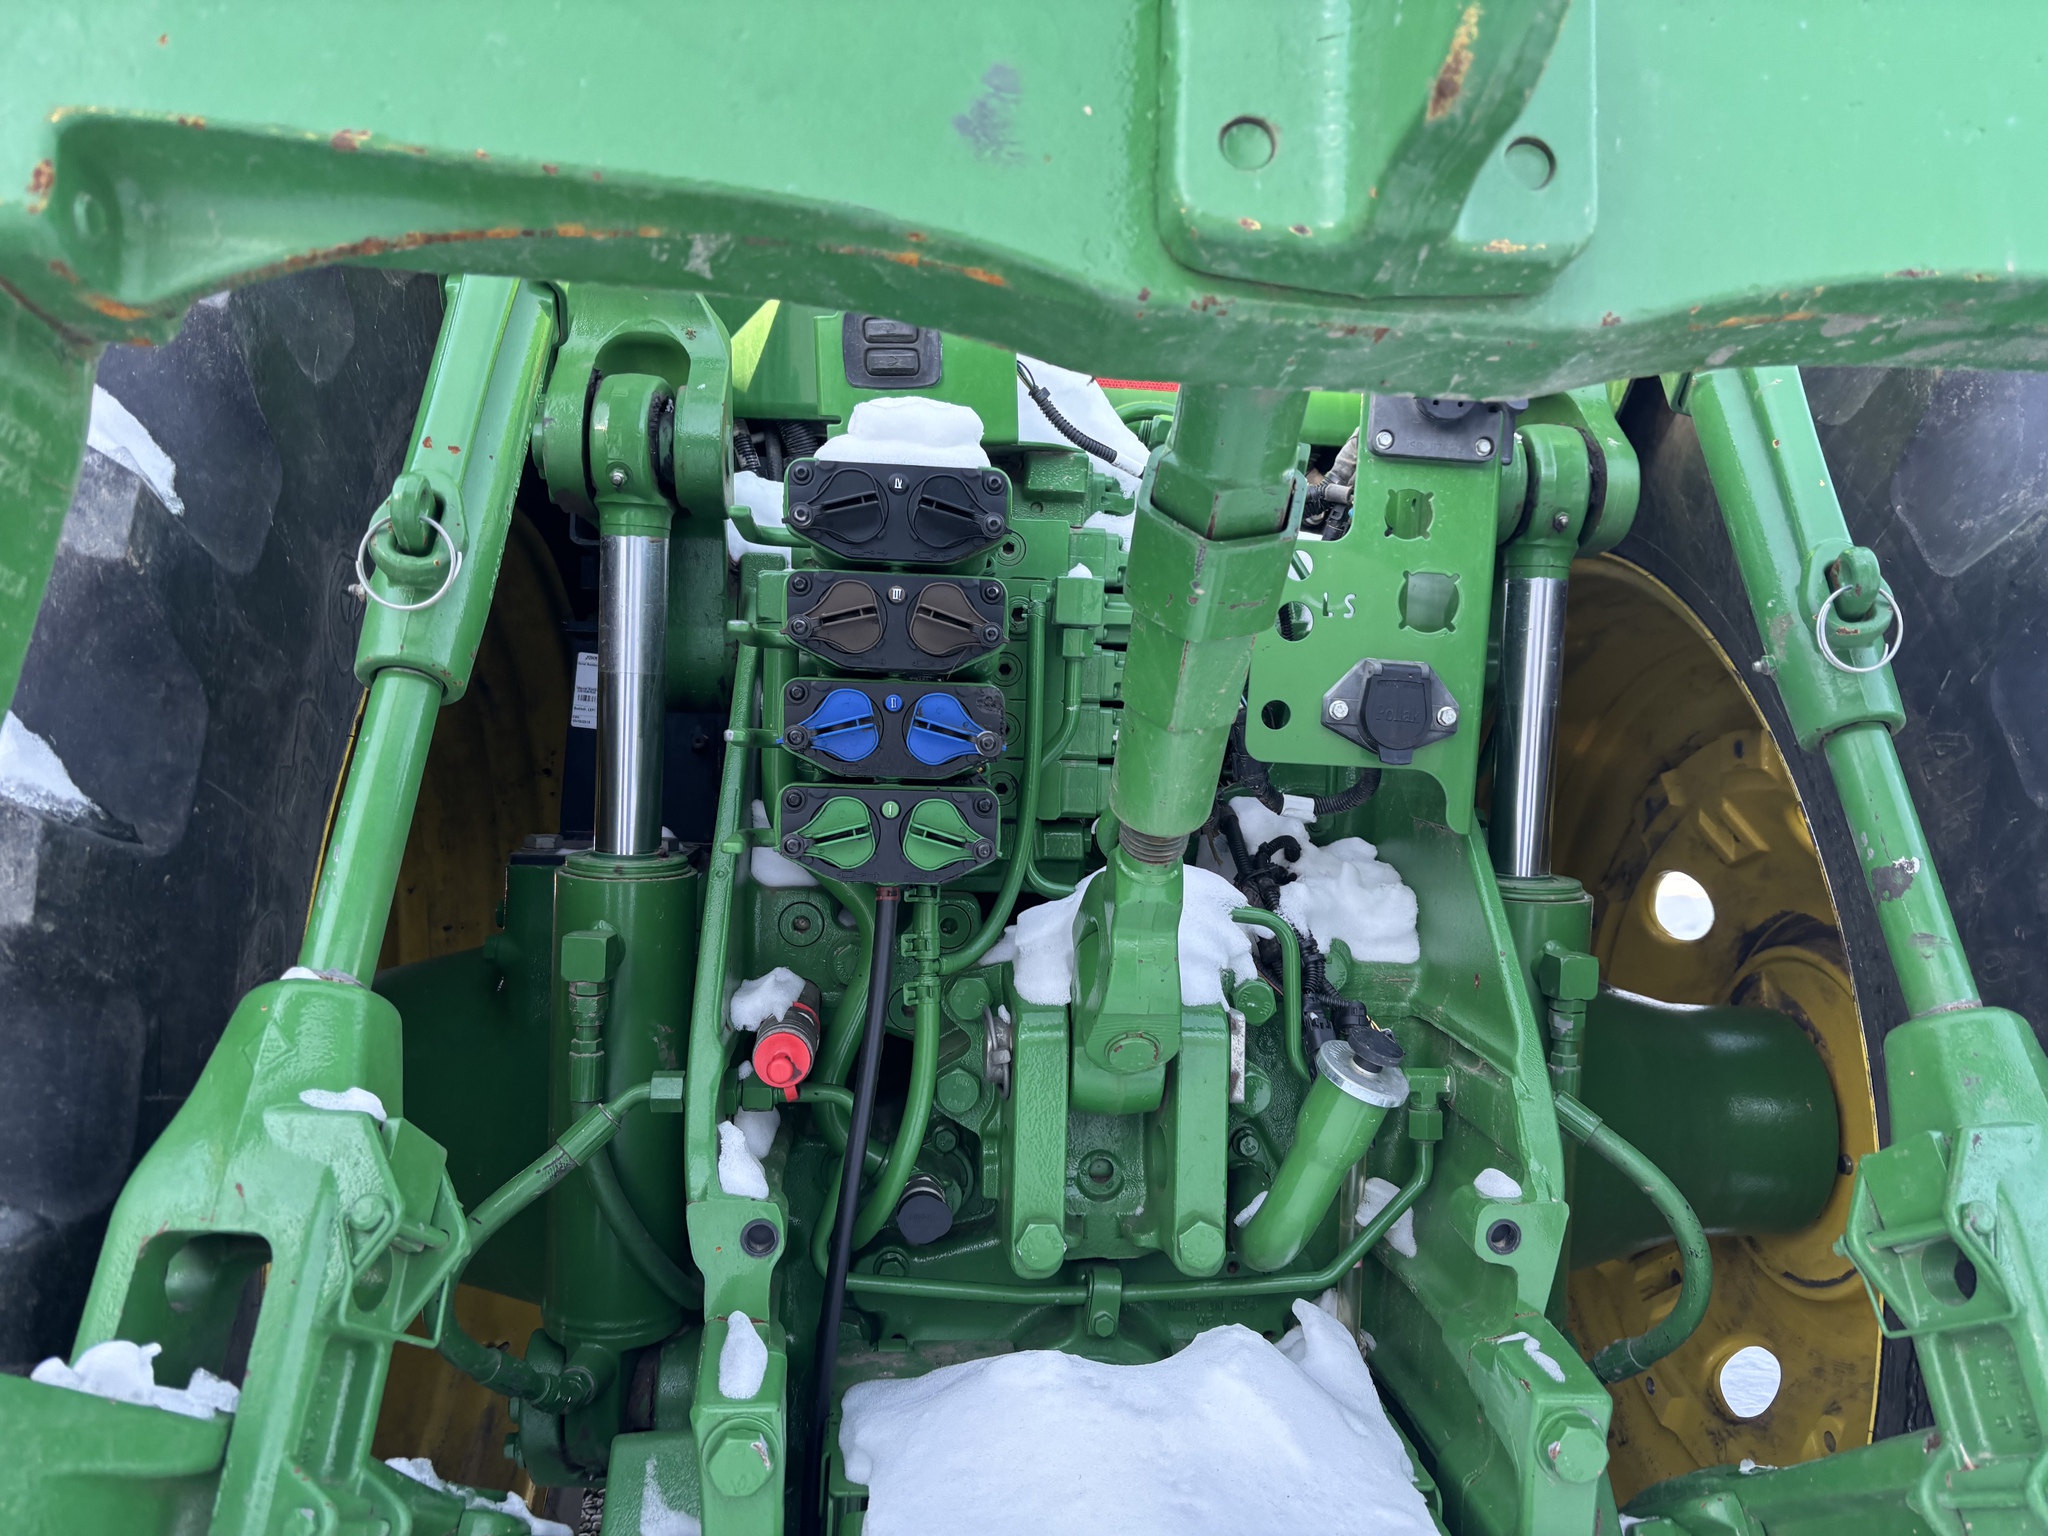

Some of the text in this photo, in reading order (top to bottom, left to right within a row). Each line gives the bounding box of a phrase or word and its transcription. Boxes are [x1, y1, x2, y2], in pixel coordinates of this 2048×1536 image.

[894, 477, 903, 489] IV
[892, 588, 902, 600] III
[890, 697, 897, 709] II
